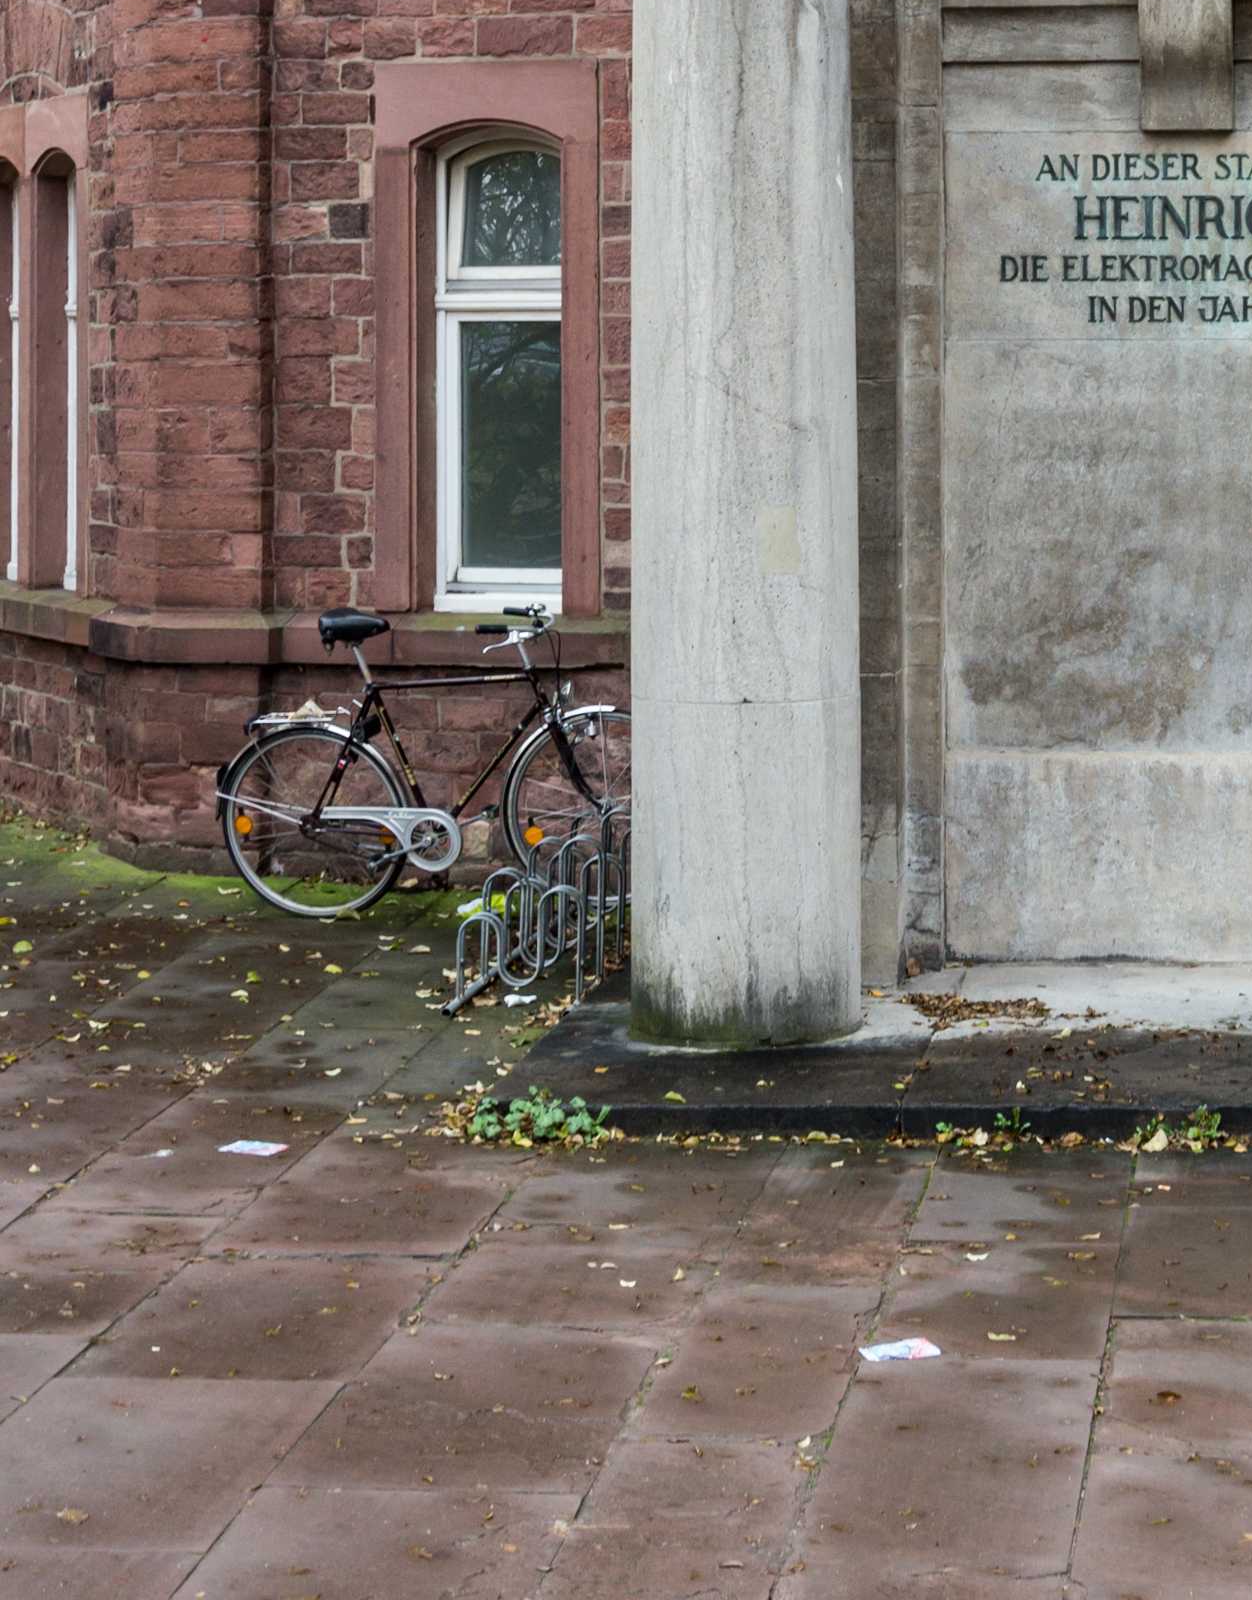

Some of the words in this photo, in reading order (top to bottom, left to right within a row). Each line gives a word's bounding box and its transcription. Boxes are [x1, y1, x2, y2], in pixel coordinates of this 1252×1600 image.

[1035, 154, 1079, 181] AN
[1091, 154, 1202, 180] DIESER
[1000, 255, 1049, 282] DIE
[1087, 296, 1118, 323] IN
[1128, 296, 1186, 322] DEN
